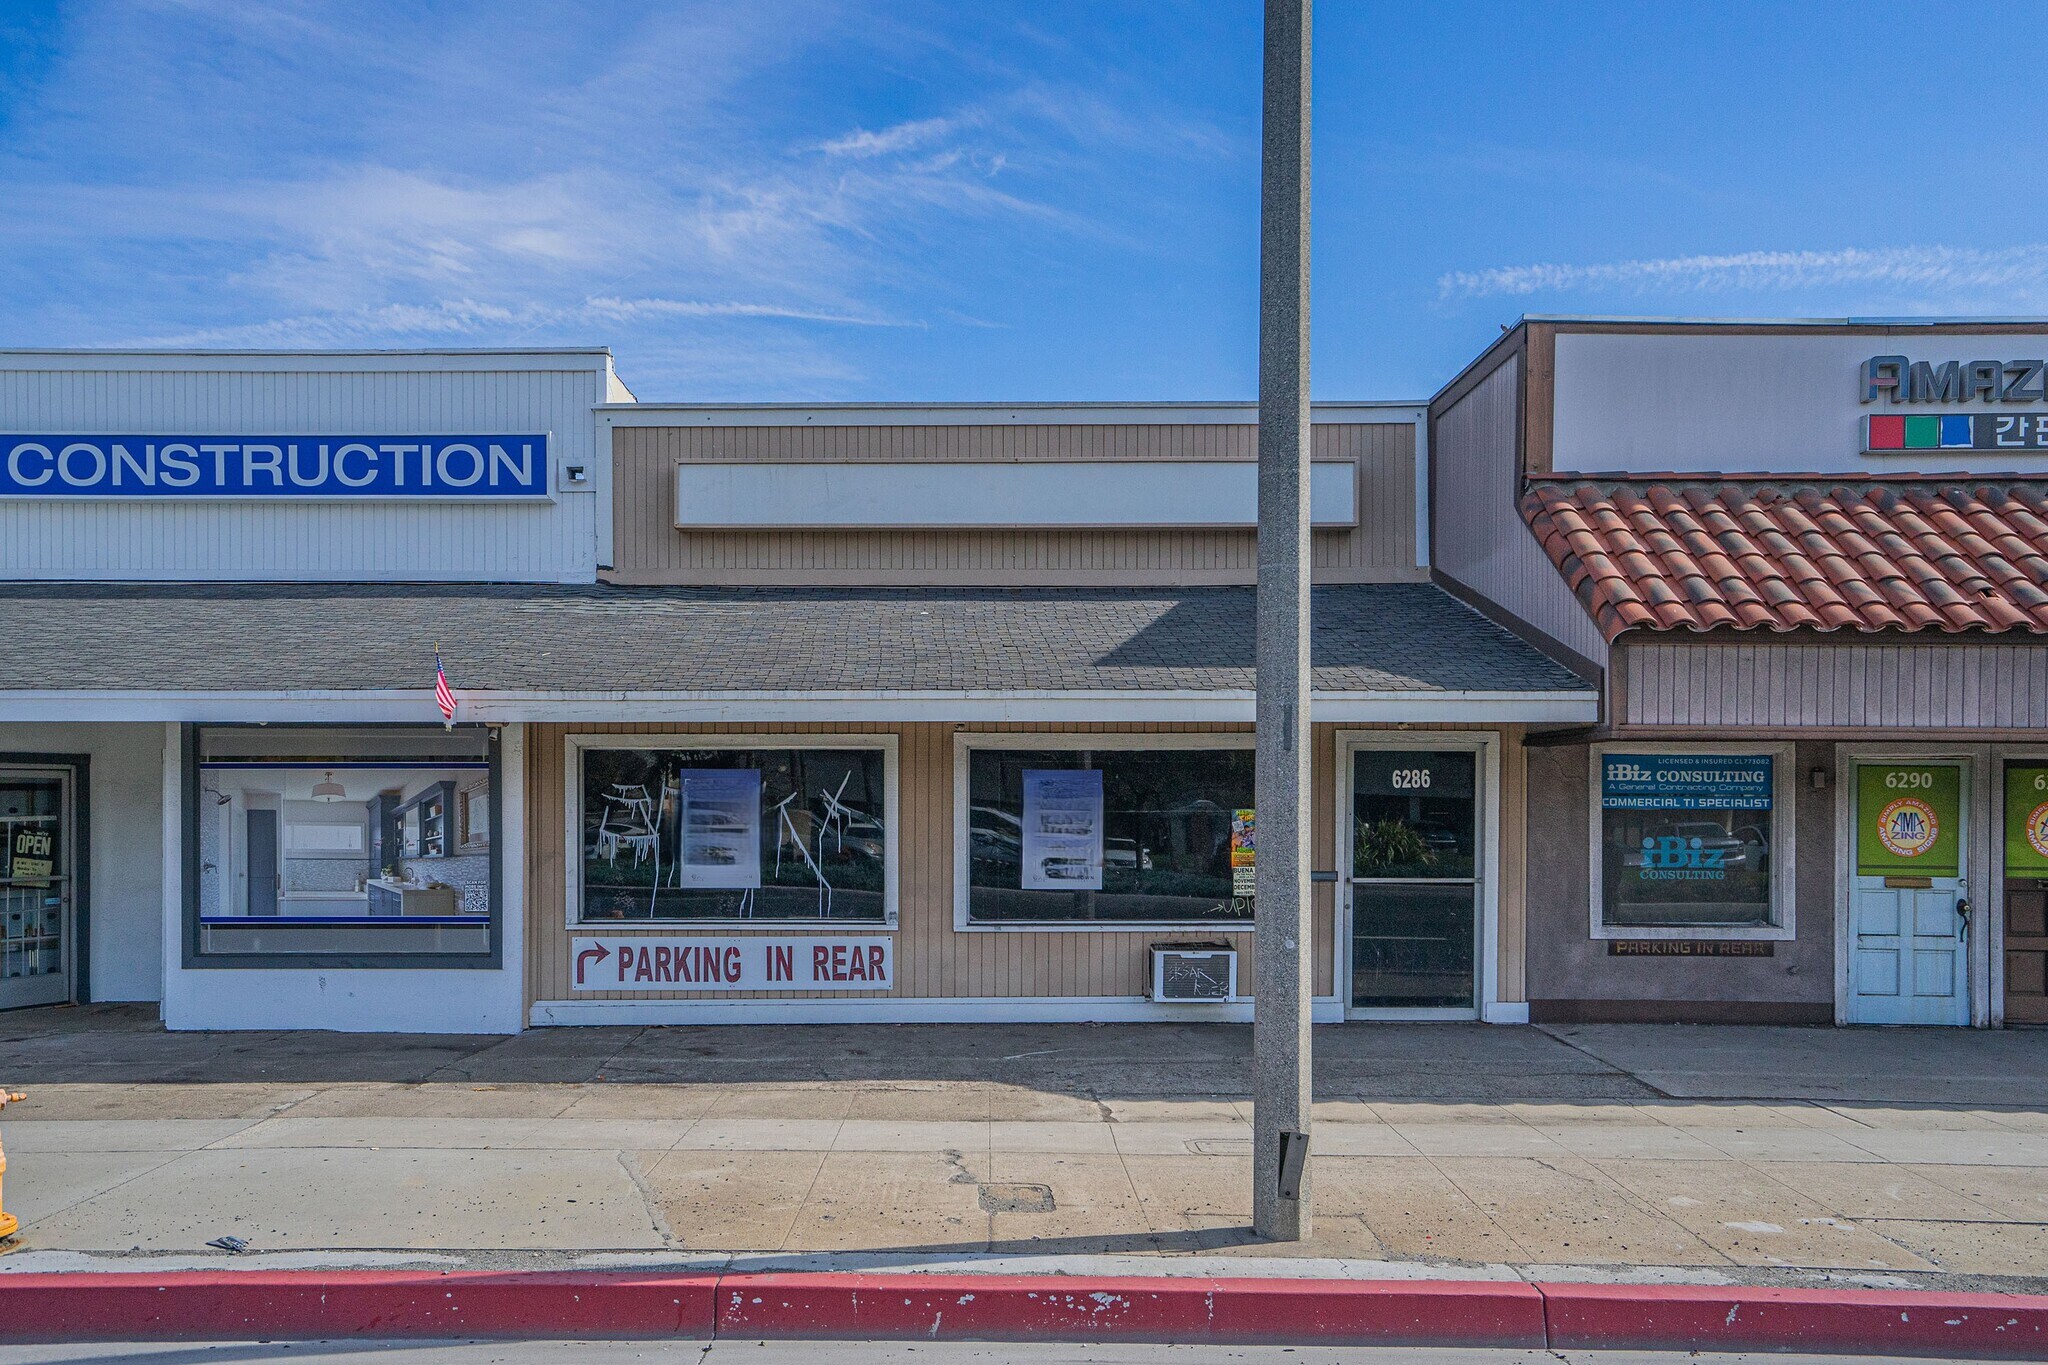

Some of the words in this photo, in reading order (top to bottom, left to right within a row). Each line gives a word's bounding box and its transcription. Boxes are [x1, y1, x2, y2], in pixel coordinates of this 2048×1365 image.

[1860, 355, 2048, 403] AMAZ
[7, 442, 533, 487] CONSTRUCTION
[1392, 769, 1431, 789] 6286
[1607, 764, 1652, 781] iBiz
[1656, 770, 1765, 783] CONSULTING
[1885, 772, 1933, 788] 6290
[1618, 783, 1656, 791] General
[1658, 783, 1716, 792] Contracting
[1719, 784, 1764, 792] Company
[1602, 798, 1680, 807] COMMERCIAL
[1684, 798, 1695, 807] TI
[1699, 798, 1770, 808] SPECIALIST
[1881, 801, 1902, 823] SIMPLY
[1906, 800, 1937, 824] AMAZING
[2029, 805, 2048, 825] SIMPL
[16, 834, 51, 856] OPEN
[1879, 827, 1913, 855] AMAZING
[1917, 827, 1937, 852] SIGNS
[1640, 836, 1724, 868] iBiz
[1640, 870, 1724, 880] CONSULTING
[1616, 941, 1691, 954] PARKING
[1696, 942, 1713, 954] IN
[1719, 942, 1765, 954] REAR
[618, 946, 742, 983] PARKING
[766, 945, 793, 981] IN
[813, 945, 886, 981] REAR
